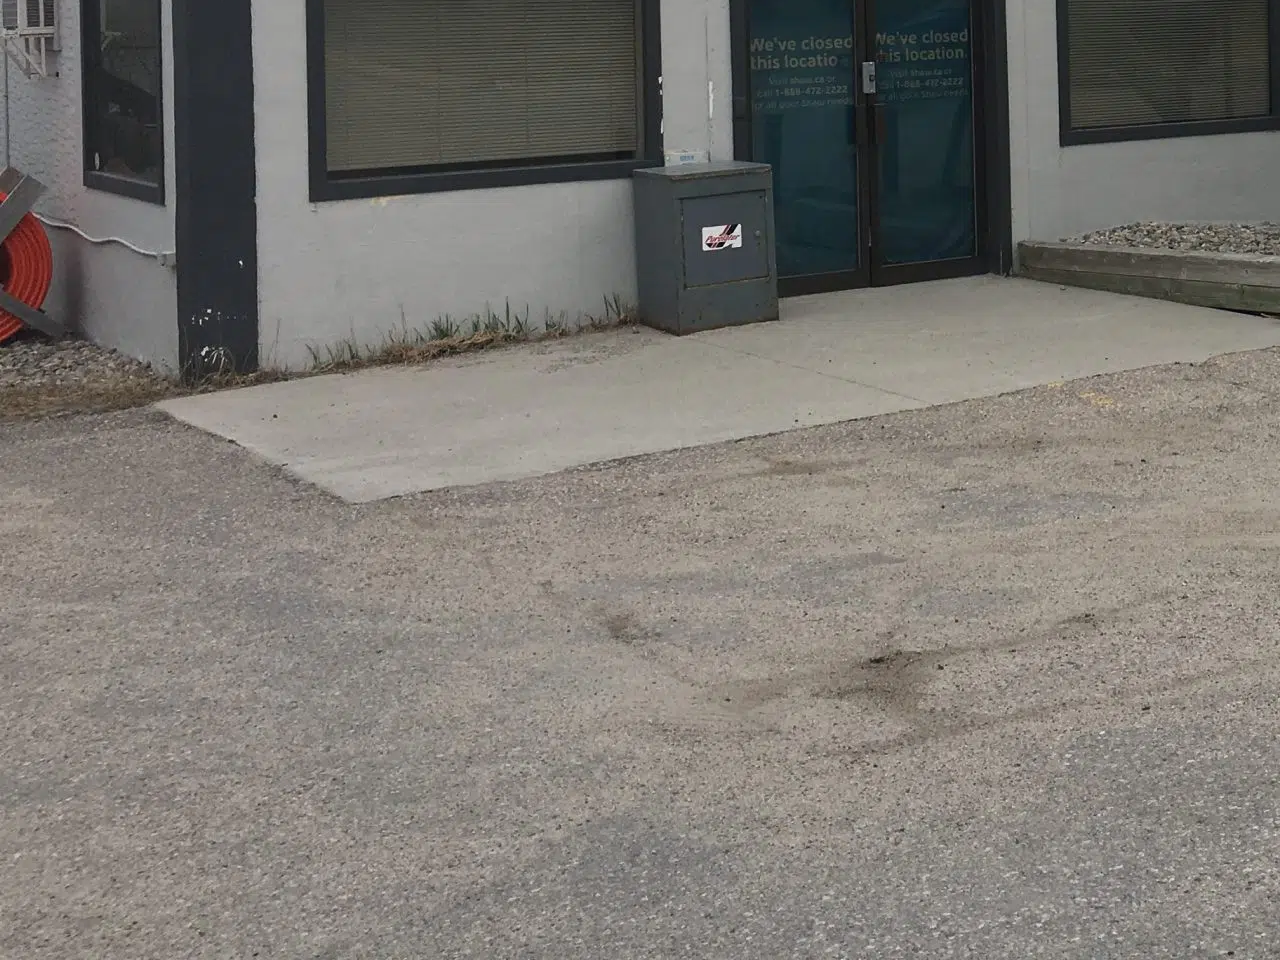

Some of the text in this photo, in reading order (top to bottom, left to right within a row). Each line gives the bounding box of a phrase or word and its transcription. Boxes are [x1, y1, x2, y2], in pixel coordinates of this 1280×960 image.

[750, 34, 853, 53] We've closed
[922, 28, 968, 44] closed
[750, 52, 838, 71] this locatio
[876, 48, 901, 63] is
